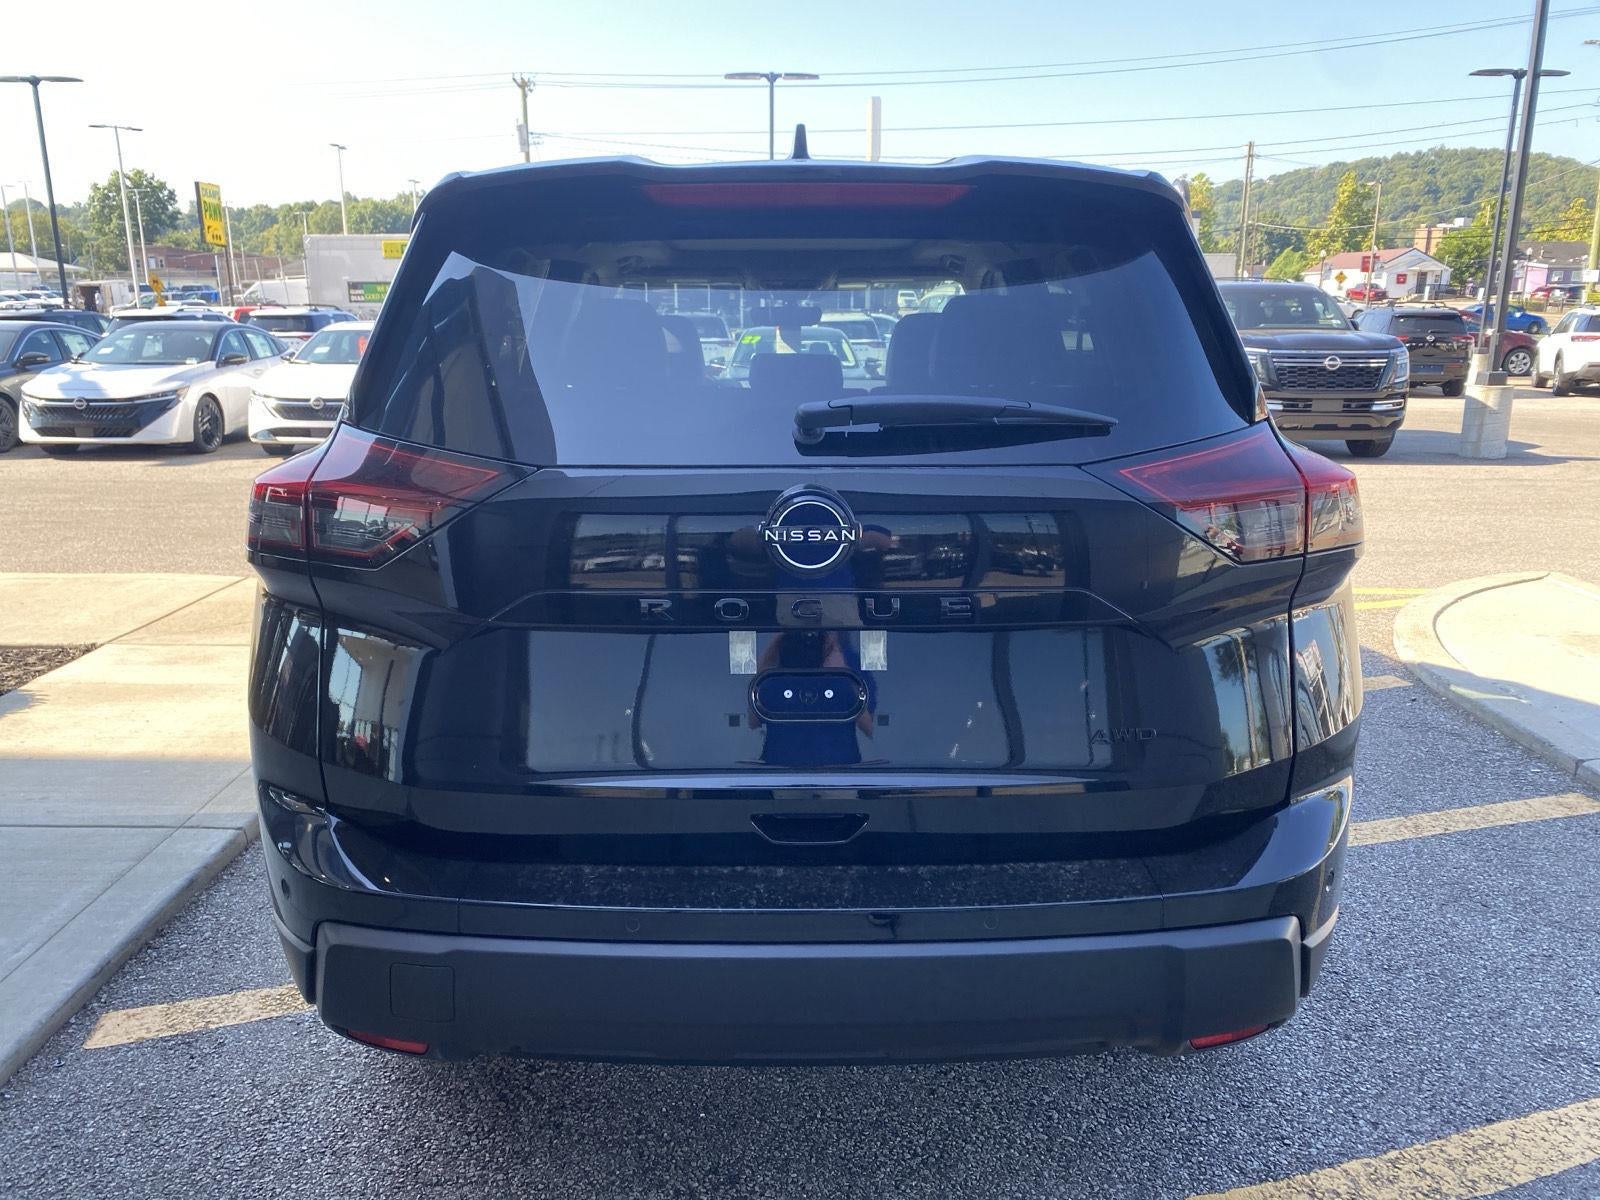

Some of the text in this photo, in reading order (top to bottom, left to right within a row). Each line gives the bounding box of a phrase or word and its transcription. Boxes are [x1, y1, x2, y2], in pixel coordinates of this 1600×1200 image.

[765, 530, 855, 541] NISSAN
[638, 598, 974, 620] ROGUE
[1090, 728, 1160, 743] AWD
